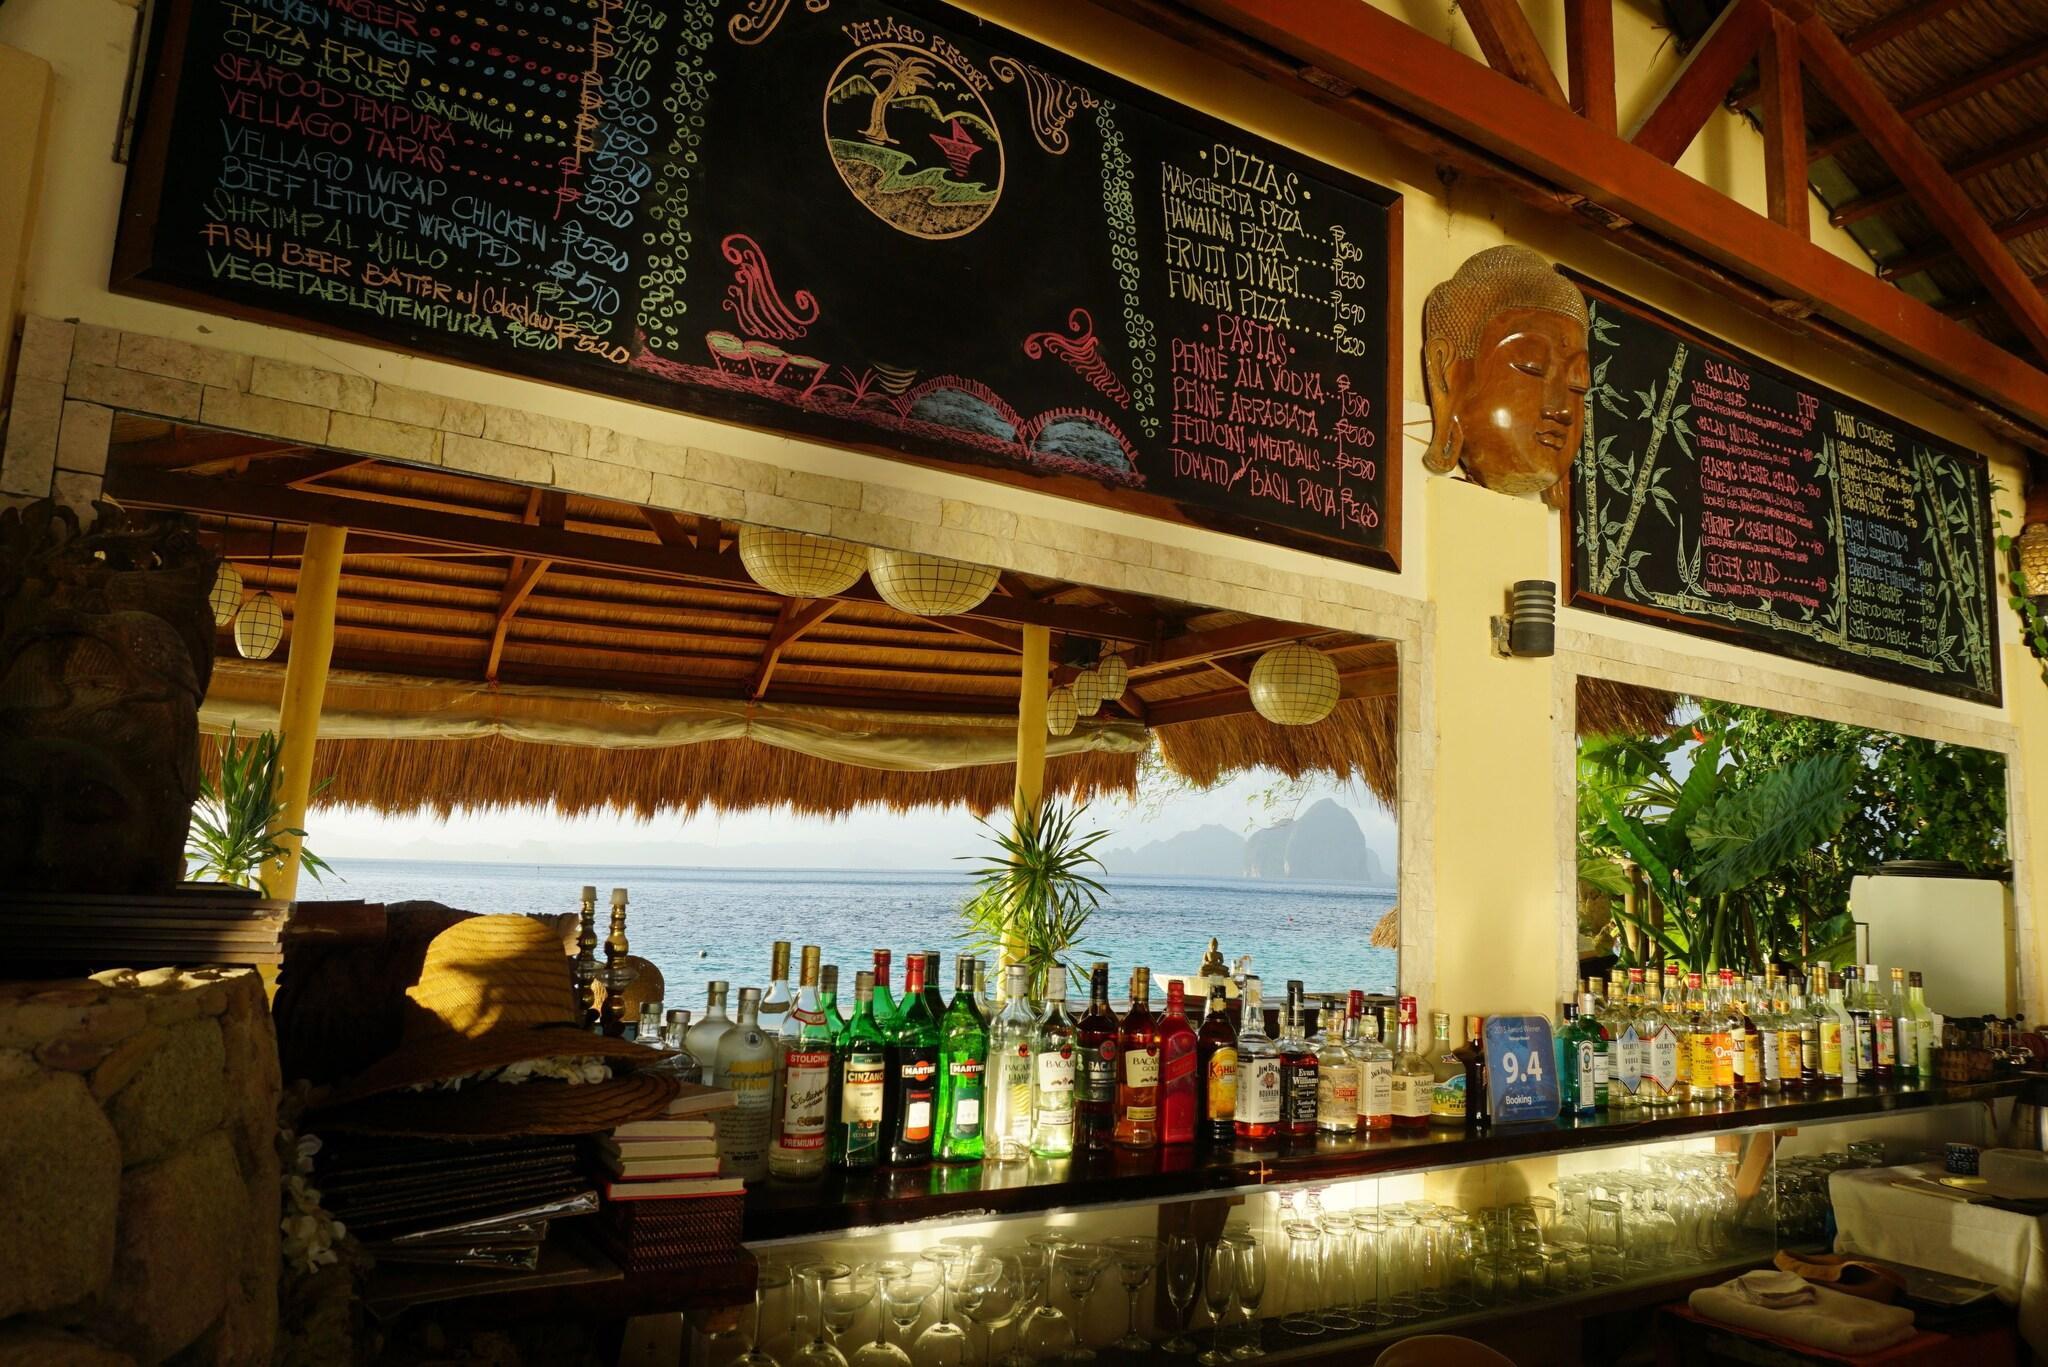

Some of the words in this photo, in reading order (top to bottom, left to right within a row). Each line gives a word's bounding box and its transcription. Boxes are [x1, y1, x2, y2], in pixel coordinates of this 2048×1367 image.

[220, 1, 311, 49] PIZZA
[320, 38, 411, 86] FRIES
[338, 16, 437, 66] FINGER
[841, 16, 926, 47] VELLAGO
[930, 35, 995, 92] RESORT
[213, 52, 345, 108] SEAFOOD
[347, 92, 456, 146] TEMPURA
[223, 29, 304, 66] CLUB
[313, 60, 408, 103] HOUSE
[411, 90, 514, 140] SANDWICH
[220, 84, 352, 145] VELLAGO
[365, 127, 446, 174] TAPAS
[219, 118, 353, 181] VELLAGO
[365, 163, 448, 207] WRAP
[451, 195, 547, 251] CHICKEN
[1161, 161, 1255, 218] MARGHERITA
[1260, 199, 1306, 238] PIZZA
[1213, 143, 1299, 206] PIZZAS
[203, 187, 325, 238] SHRIMP
[323, 218, 360, 250] AL
[218, 156, 307, 201] BEEF
[417, 209, 521, 267] WRAPPED
[1240, 222, 1291, 261] PIZZA
[199, 222, 273, 258] FISH
[281, 240, 352, 278] BEER
[361, 262, 452, 303] BATTER
[1164, 233, 1229, 279] FRUTTI
[1235, 251, 1256, 287] DI
[1258, 254, 1300, 299] MARI
[1168, 269, 1234, 313] FUNGHI
[1239, 289, 1291, 331] PIZZA
[1217, 314, 1287, 366] PASTAS
[1170, 338, 1229, 382] PENNE
[1234, 358, 1265, 391] ALA
[1266, 362, 1326, 406] VODKA
[1704, 360, 1750, 391] SALADS
[1172, 376, 1227, 420] PENNE
[1228, 391, 1320, 438] ARRABIATA
[1834, 410, 1856, 439] MAIN
[1857, 422, 1895, 452] COURSE
[1168, 447, 1230, 488] TOMATO
[1251, 466, 1296, 504] BASIL
[1297, 477, 1336, 518] PASTA
[1701, 456, 1738, 481] CLASSIC
[1701, 511, 1735, 538] SHRIMP
[1842, 515, 1864, 540] FISH
[1706, 552, 1745, 582] GREEK
[1746, 559, 1781, 585] SALAD
[1849, 597, 1881, 618] SEAFOOD
[1849, 617, 1886, 640] SEAFOOD
[847, 1071, 884, 1082] CINZANO
[1257, 1064, 1269, 1078] JIM
[1502, 1050, 1543, 1084] 9.4
